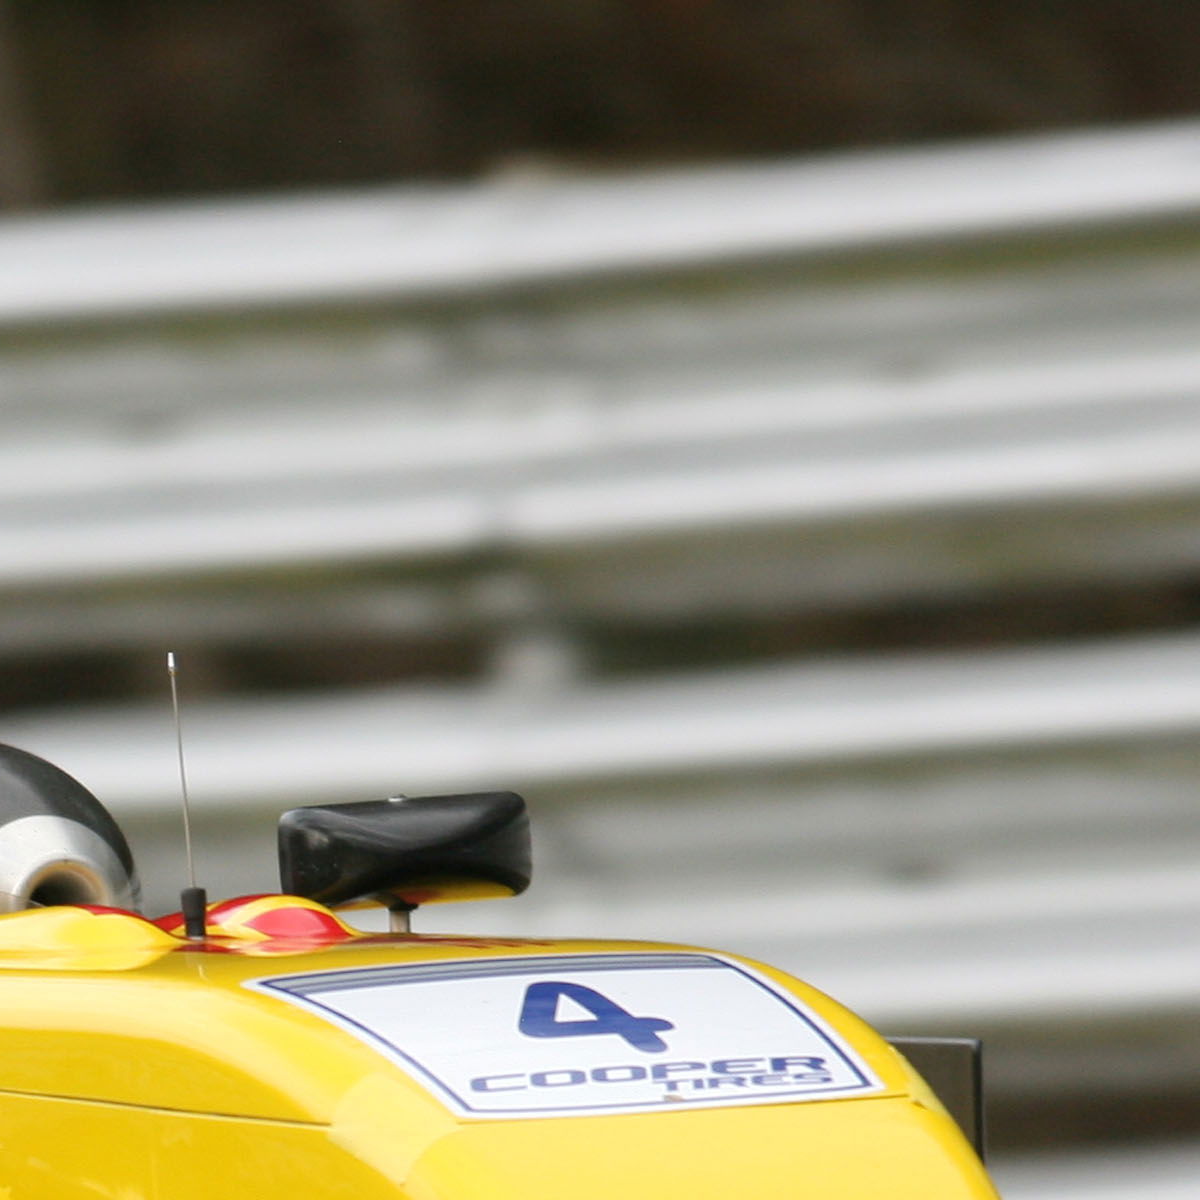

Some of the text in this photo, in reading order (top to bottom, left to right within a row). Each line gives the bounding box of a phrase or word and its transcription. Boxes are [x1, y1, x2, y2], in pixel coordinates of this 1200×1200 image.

[519, 981, 675, 1053] 4
[470, 1056, 826, 1092] COOPER
[653, 1072, 833, 1091] TIRES
